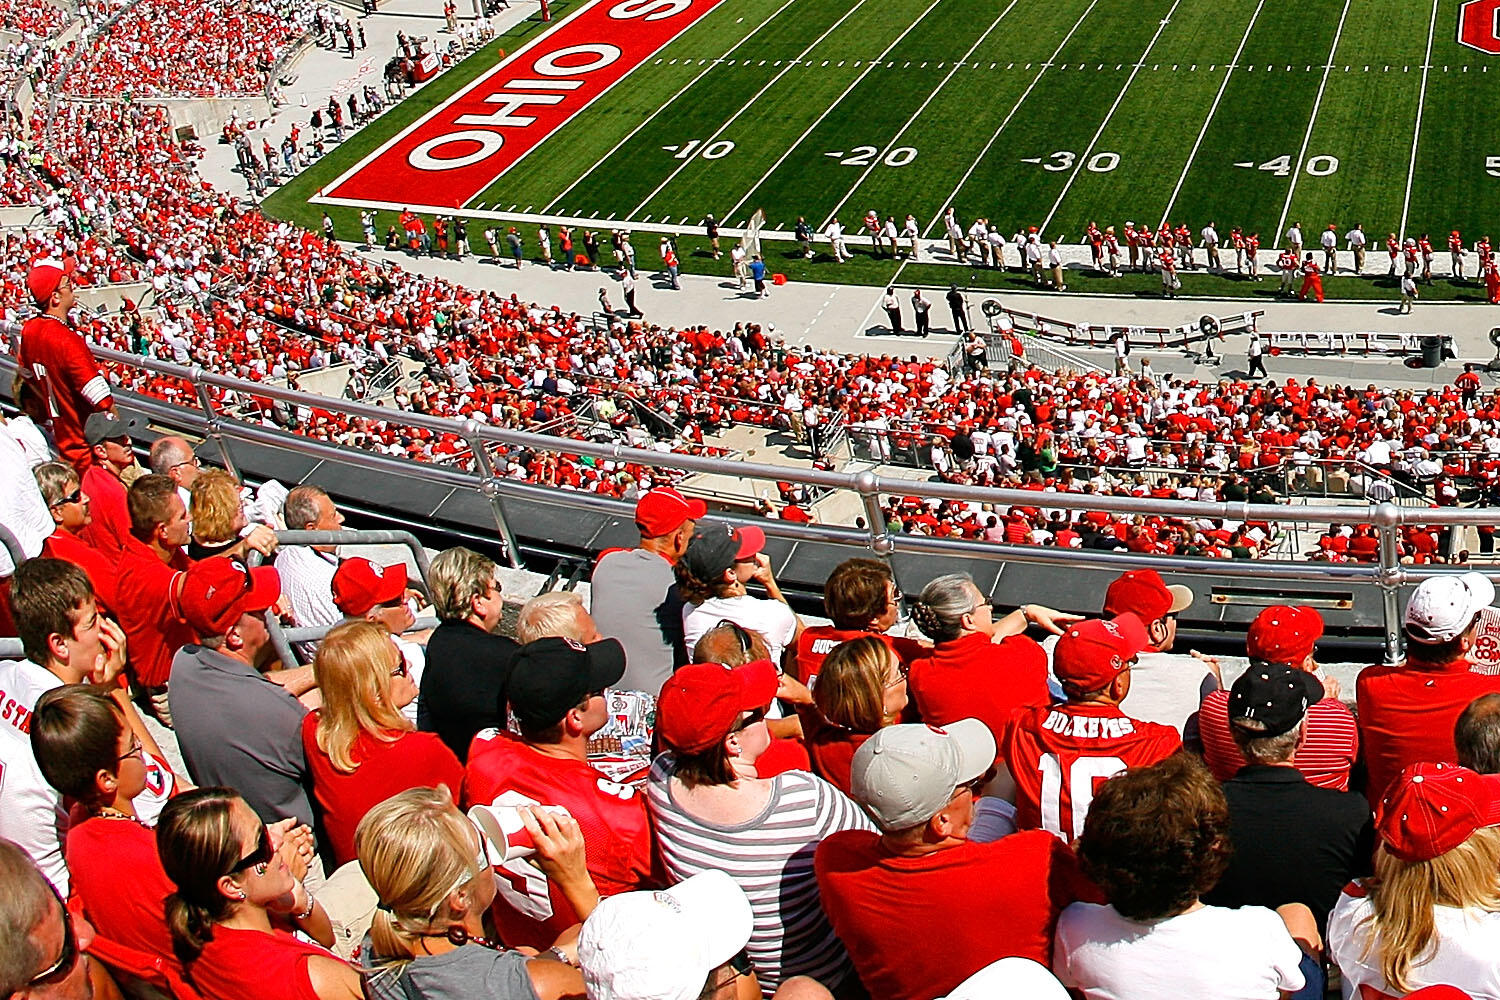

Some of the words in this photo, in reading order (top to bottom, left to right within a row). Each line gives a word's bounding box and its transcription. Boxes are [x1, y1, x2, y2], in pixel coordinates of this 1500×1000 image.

[408, 42, 622, 172] OHIO
[673, 138, 737, 160] 10
[843, 145, 919, 167] 20
[1042, 151, 1122, 173] 30
[1258, 154, 1340, 177] 40
[1475, 636, 1498, 653] POP
